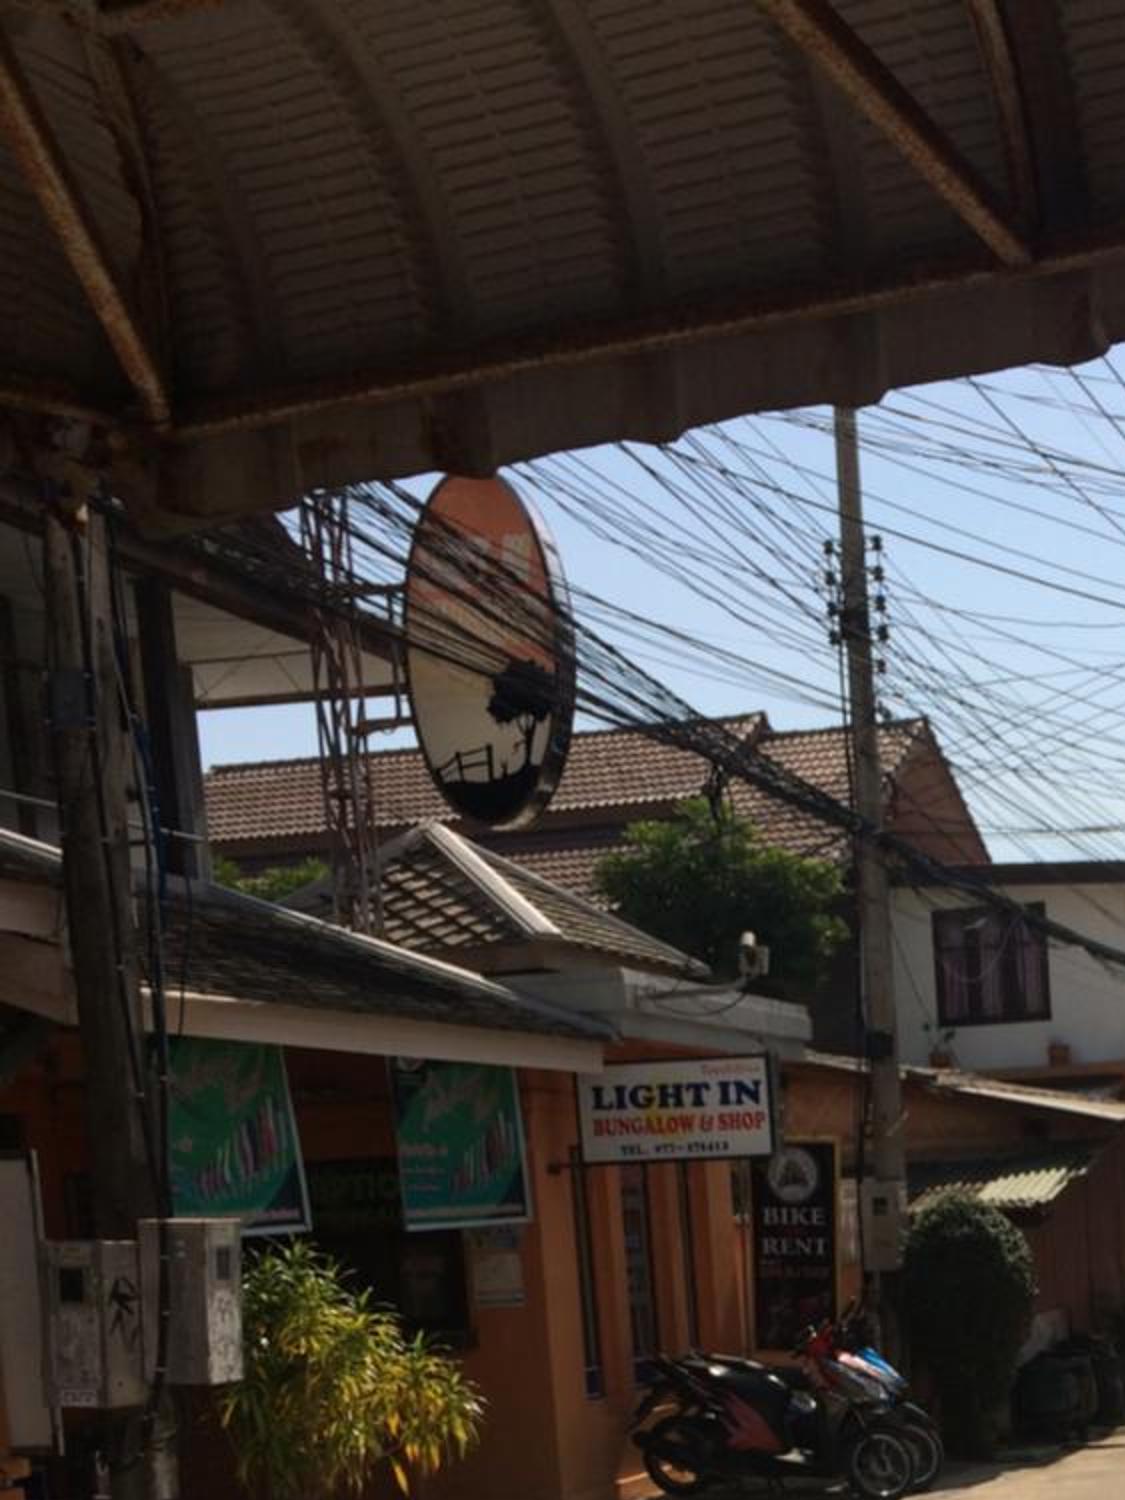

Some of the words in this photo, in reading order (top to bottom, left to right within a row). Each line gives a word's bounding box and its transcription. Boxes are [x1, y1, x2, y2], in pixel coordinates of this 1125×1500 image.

[592, 1083, 709, 1110] LIGHT
[718, 1080, 762, 1105] IN
[594, 1114, 697, 1137] BUNGALOW
[700, 1115, 715, 1132] &
[717, 1111, 766, 1131] SHOP
[762, 1206, 827, 1227] BIKE
[761, 1238, 828, 1257] RENT
